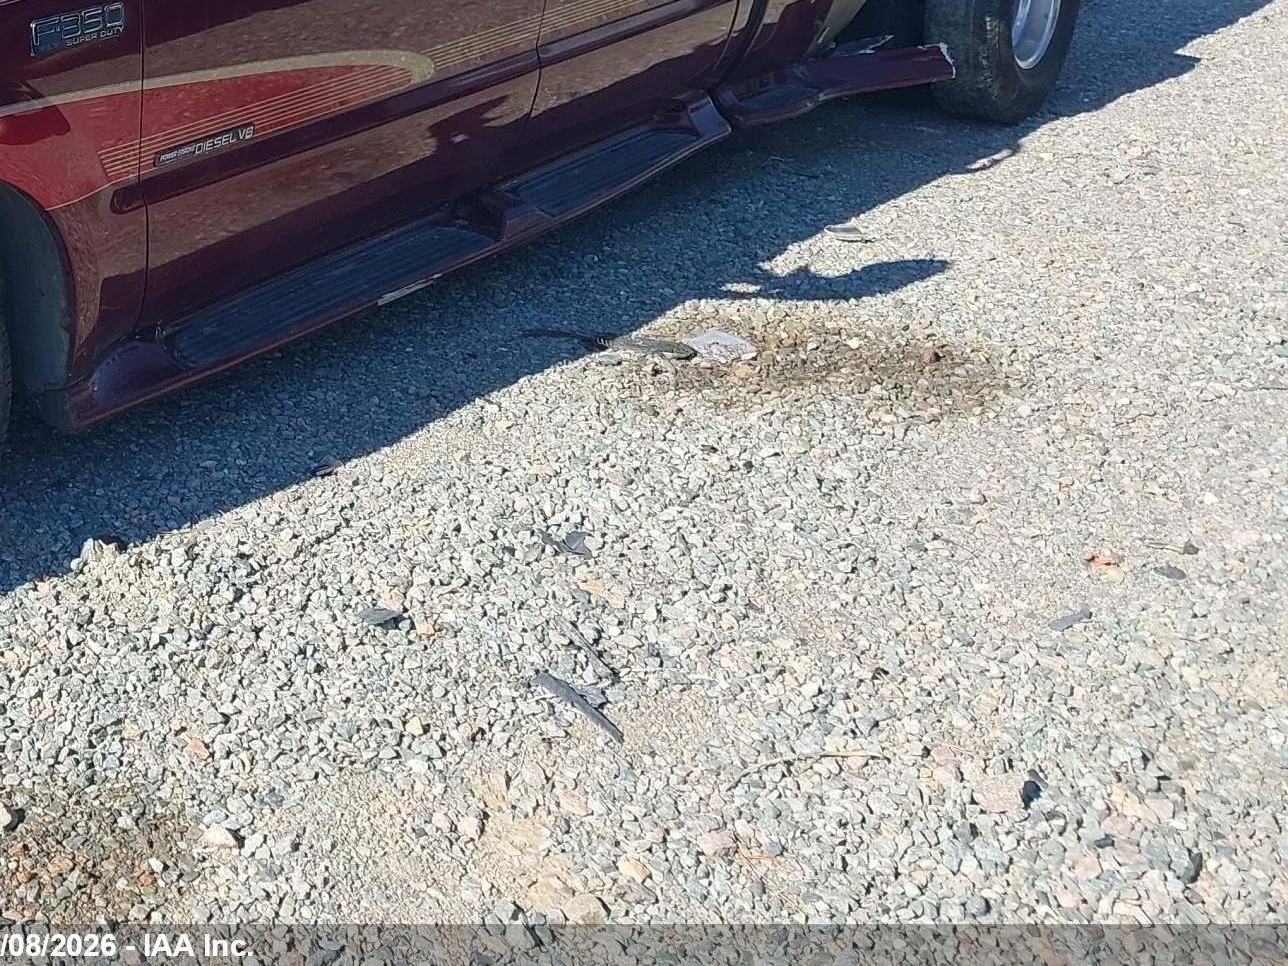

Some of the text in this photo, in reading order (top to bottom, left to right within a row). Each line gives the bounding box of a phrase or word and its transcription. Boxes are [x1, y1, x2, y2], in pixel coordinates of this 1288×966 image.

[65, 24, 125, 47] SUPER DUTY
[195, 134, 236, 155] DIESEL
[238, 126, 254, 140] V8
